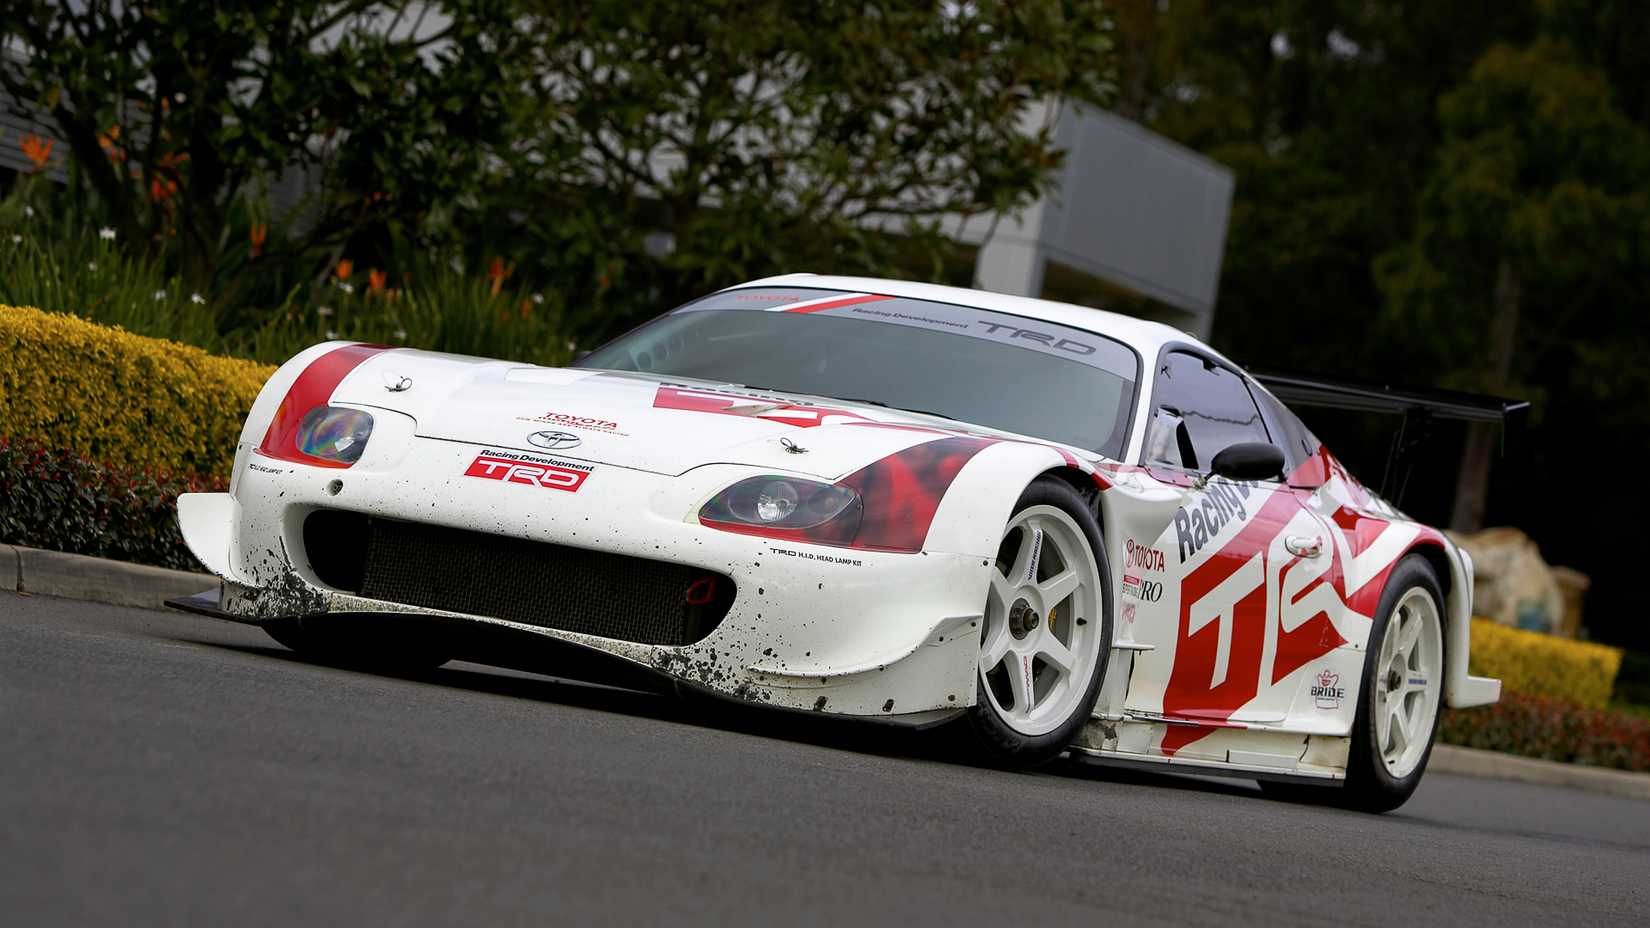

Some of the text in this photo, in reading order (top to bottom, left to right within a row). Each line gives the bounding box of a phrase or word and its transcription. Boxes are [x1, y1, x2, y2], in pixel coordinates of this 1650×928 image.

[977, 320, 1097, 356] TRD
[546, 411, 617, 428] TOYOTA
[480, 449, 594, 472] Racing Development
[478, 459, 580, 488] TRD
[769, 547, 797, 557] TRD
[816, 554, 834, 563] HEAD
[835, 557, 852, 566] LAMP
[1134, 544, 1165, 573] TOYOTA
[1310, 686, 1345, 699] BRIDE
